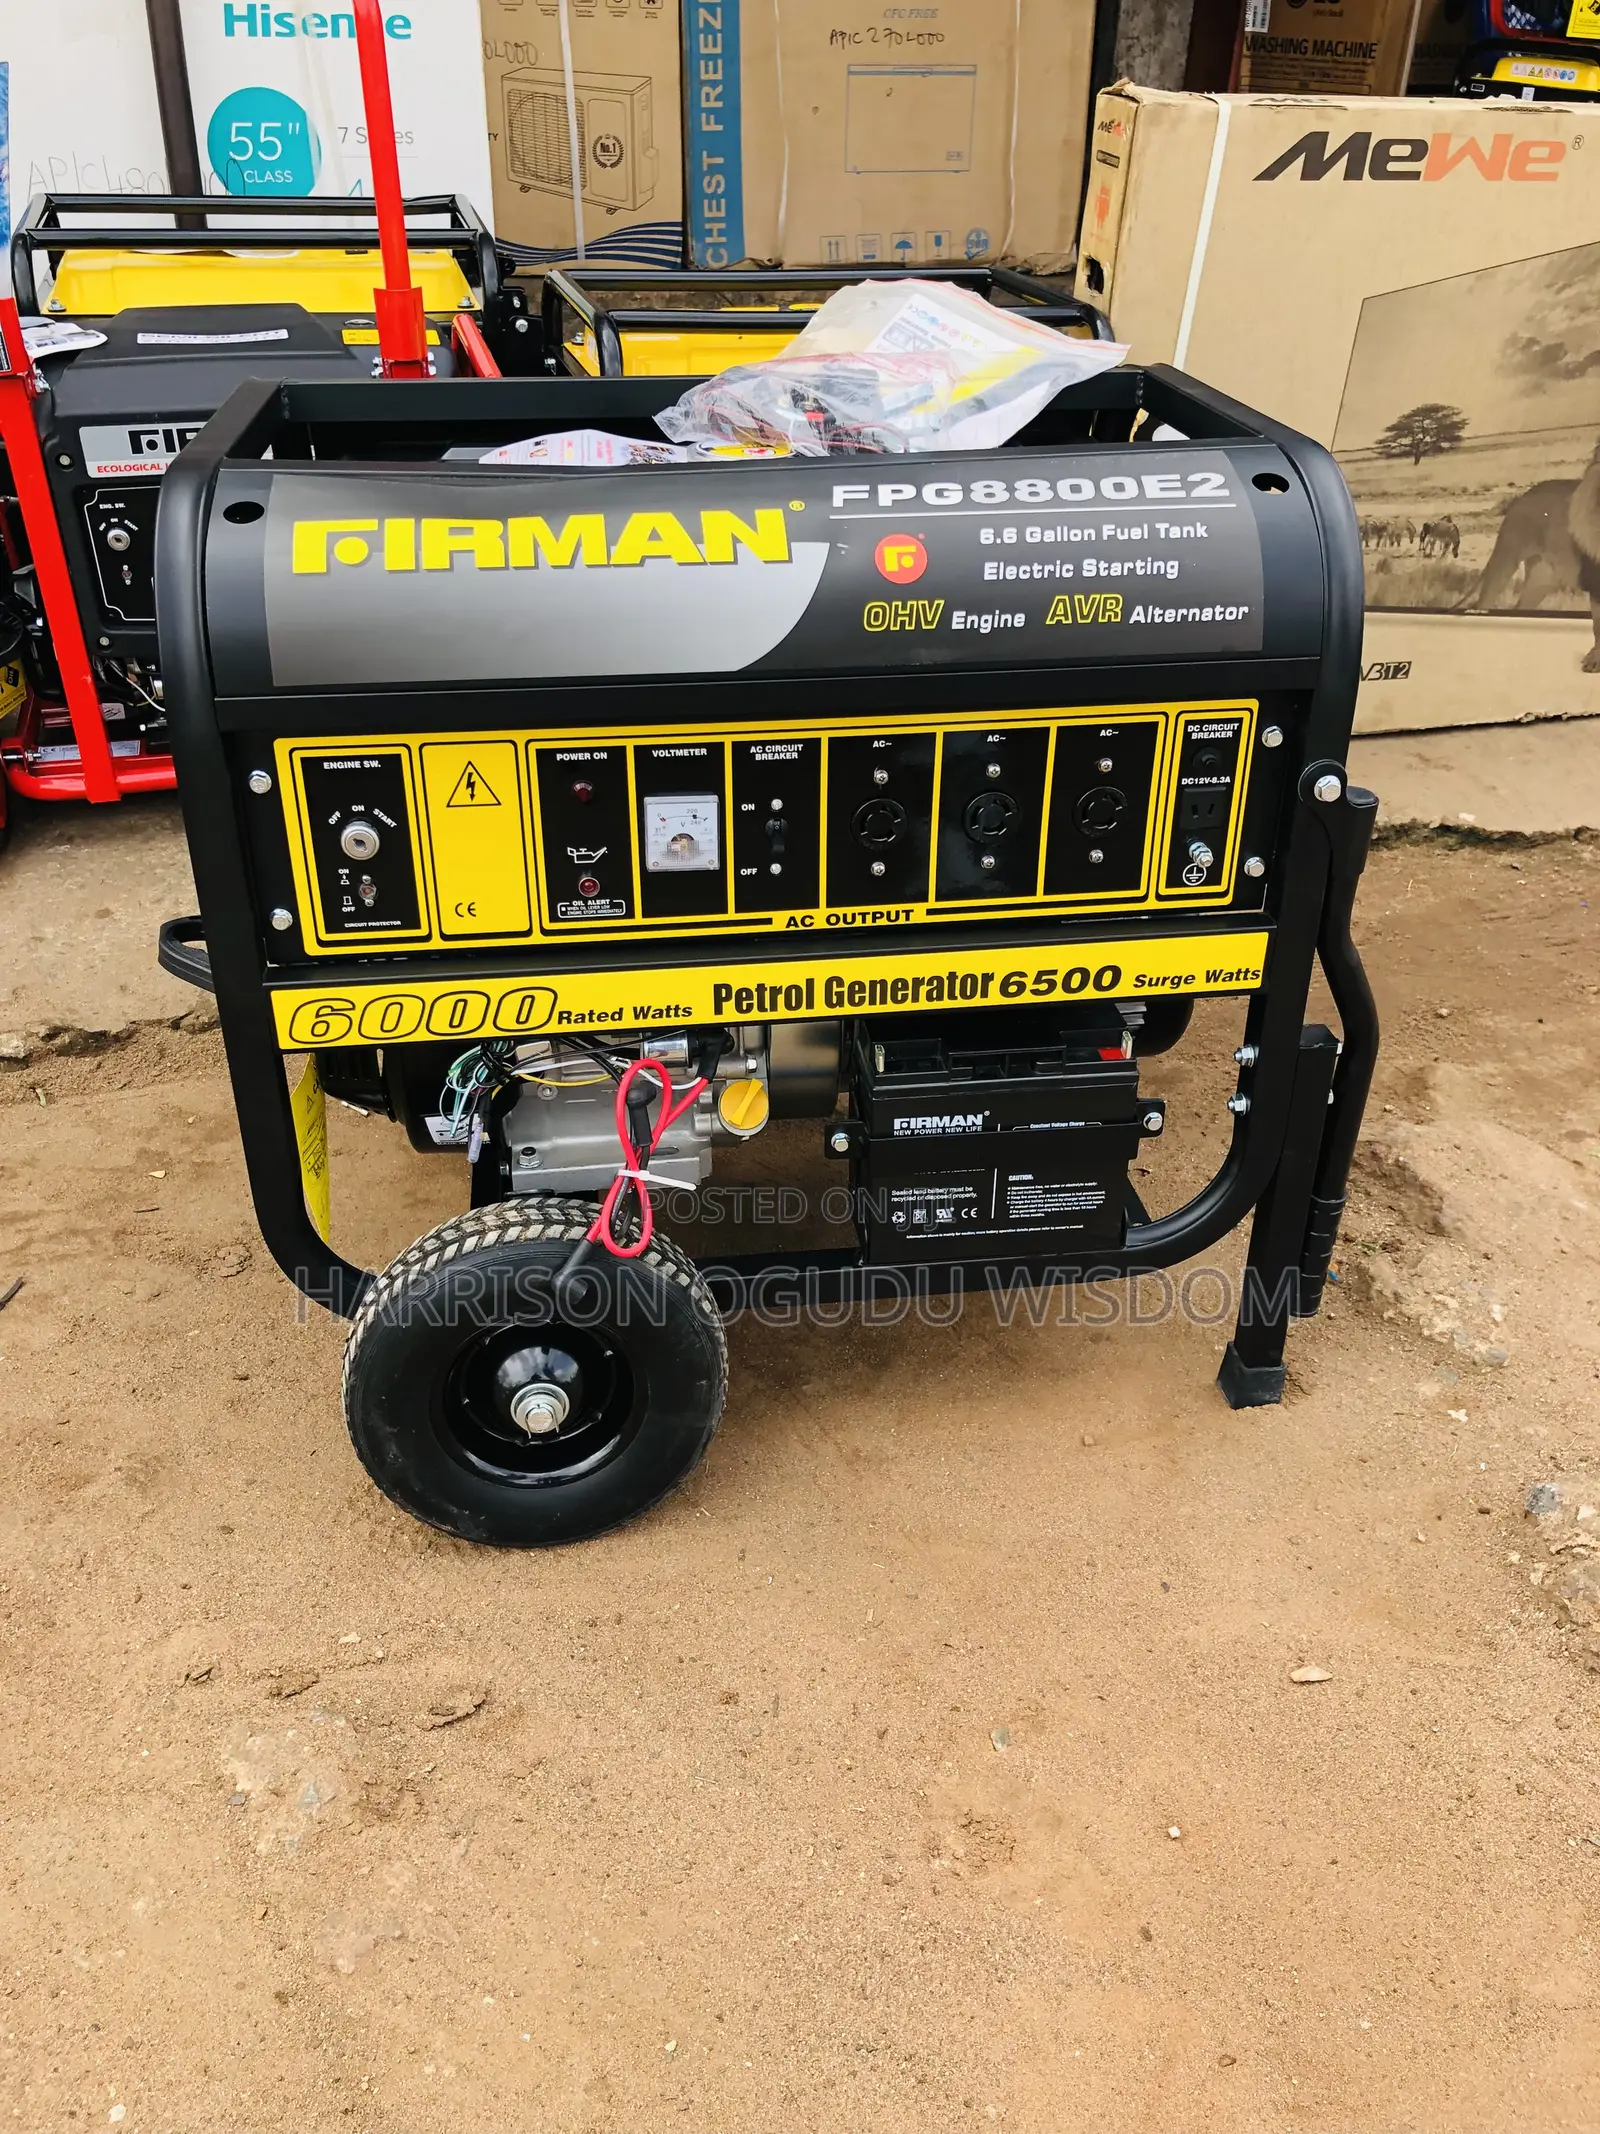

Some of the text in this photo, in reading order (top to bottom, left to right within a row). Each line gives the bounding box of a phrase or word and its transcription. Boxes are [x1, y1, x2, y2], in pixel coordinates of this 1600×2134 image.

[223, 3, 412, 39] Hisene
[883, 8, 940, 19] CFC FREE
[1245, 36, 1378, 60] WASHING MACHINE
[228, 121, 300, 162] 55"
[337, 126, 349, 145] 7
[1251, 131, 1567, 182] MeWe
[244, 169, 293, 183] CLASS
[703, 151, 728, 267] CHEST
[97, 463, 163, 473] ECOLOGICAL
[831, 471, 1231, 508] FPG8800E2
[292, 508, 790, 574] FIRMAN
[979, 521, 1209, 545] 6.6 Gallon Fuel Tank
[983, 558, 1180, 581] Electric Starting
[862, 599, 1026, 634] OHV Engine
[1045, 593, 1249, 625] AVR Alternator
[1187, 723, 1239, 733] DC CIRCUIT
[1191, 730, 1233, 740] BREAKER
[556, 751, 608, 761] POWER ON
[652, 748, 707, 758] VOLTMETER
[750, 743, 803, 753] AC CIRCUIT
[755, 751, 798, 761] BREAKER
[323, 760, 381, 770] ENGINE SW.
[351, 804, 365, 812] ON
[328, 811, 342, 825] OFF
[373, 808, 398, 828] START
[740, 868, 757, 876] OFF
[454, 901, 477, 918] CE
[785, 909, 914, 929] AC OUTPUT
[999, 964, 1261, 998] 6500 Surge Watts
[712, 969, 995, 1016] Petrol Generator
[288, 985, 693, 1046] 6000 Rated Watts
[893, 1114, 983, 1130] FIRMAN
[961, 1207, 978, 1219] CE
